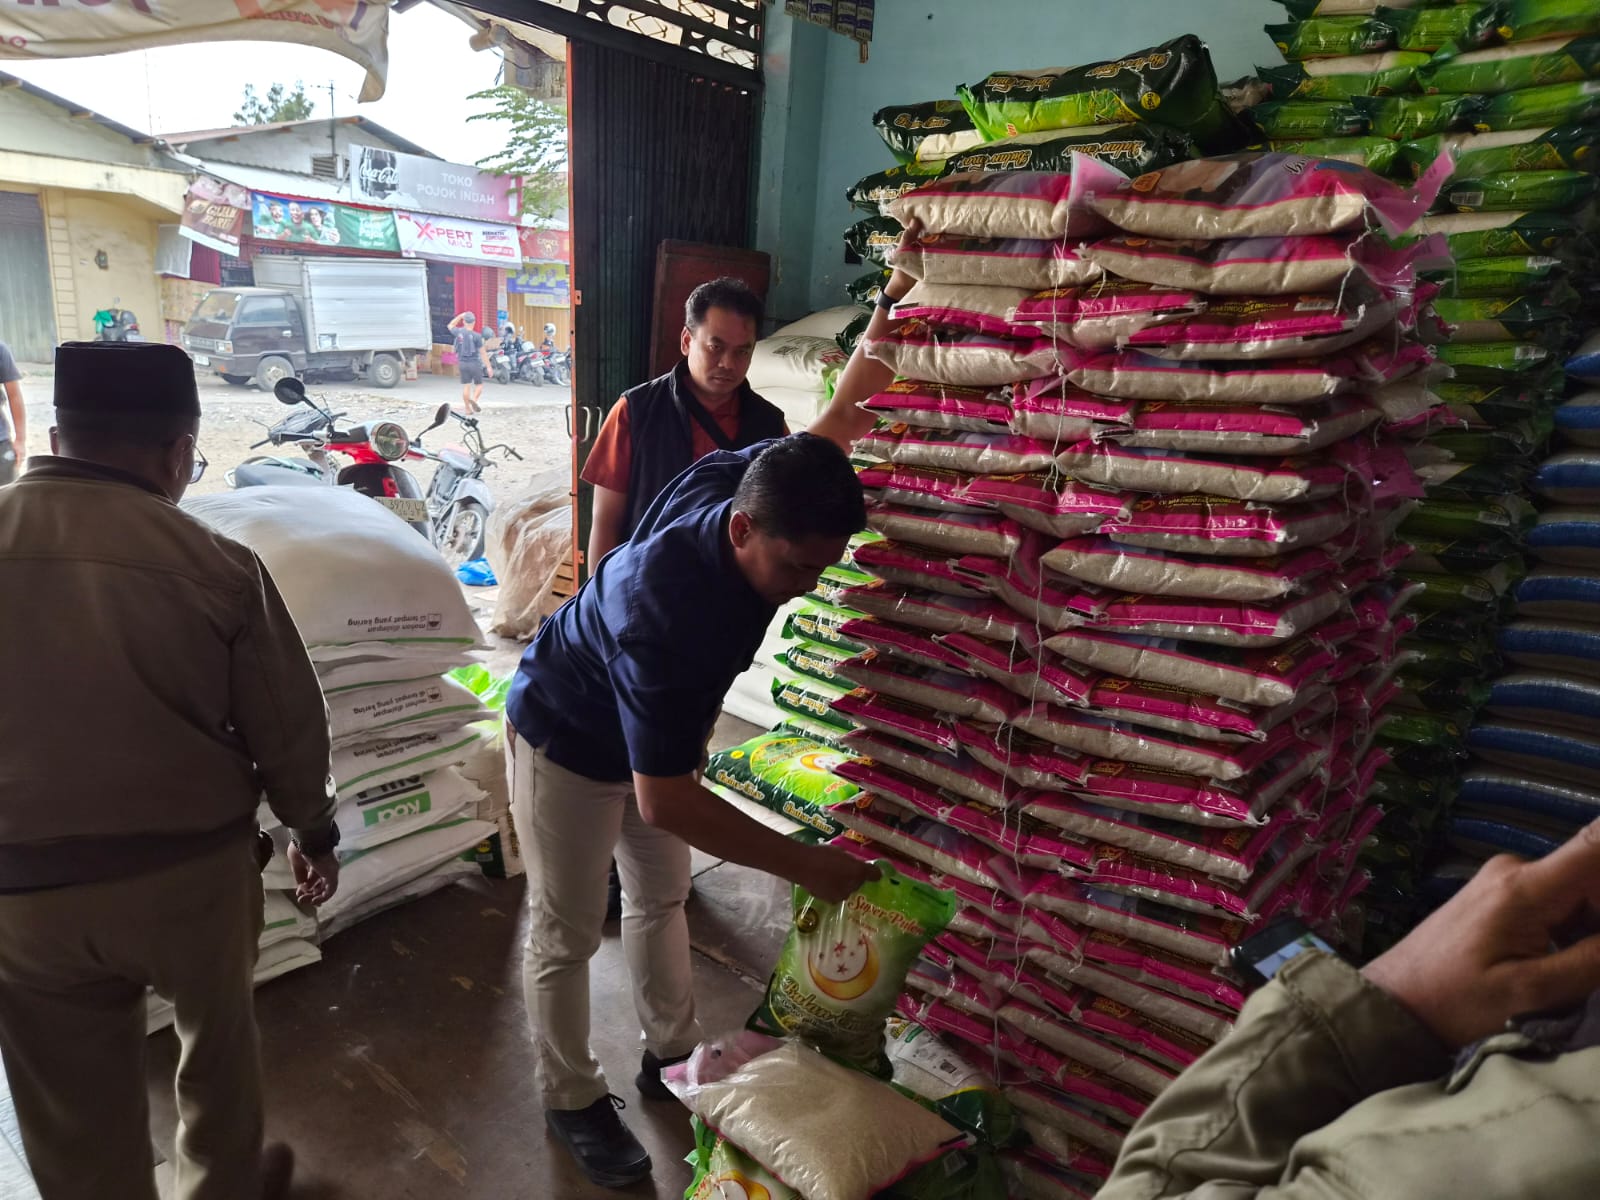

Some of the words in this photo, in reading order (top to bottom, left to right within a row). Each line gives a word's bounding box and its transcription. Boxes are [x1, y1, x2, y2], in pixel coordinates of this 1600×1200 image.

[441, 173, 473, 187] TOKO
[415, 183, 457, 199] POJOK
[459, 190, 496, 205] INDAH
[414, 220, 473, 241] X-PERT
[448, 239, 473, 248] MILD
[847, 894, 888, 919] Super
